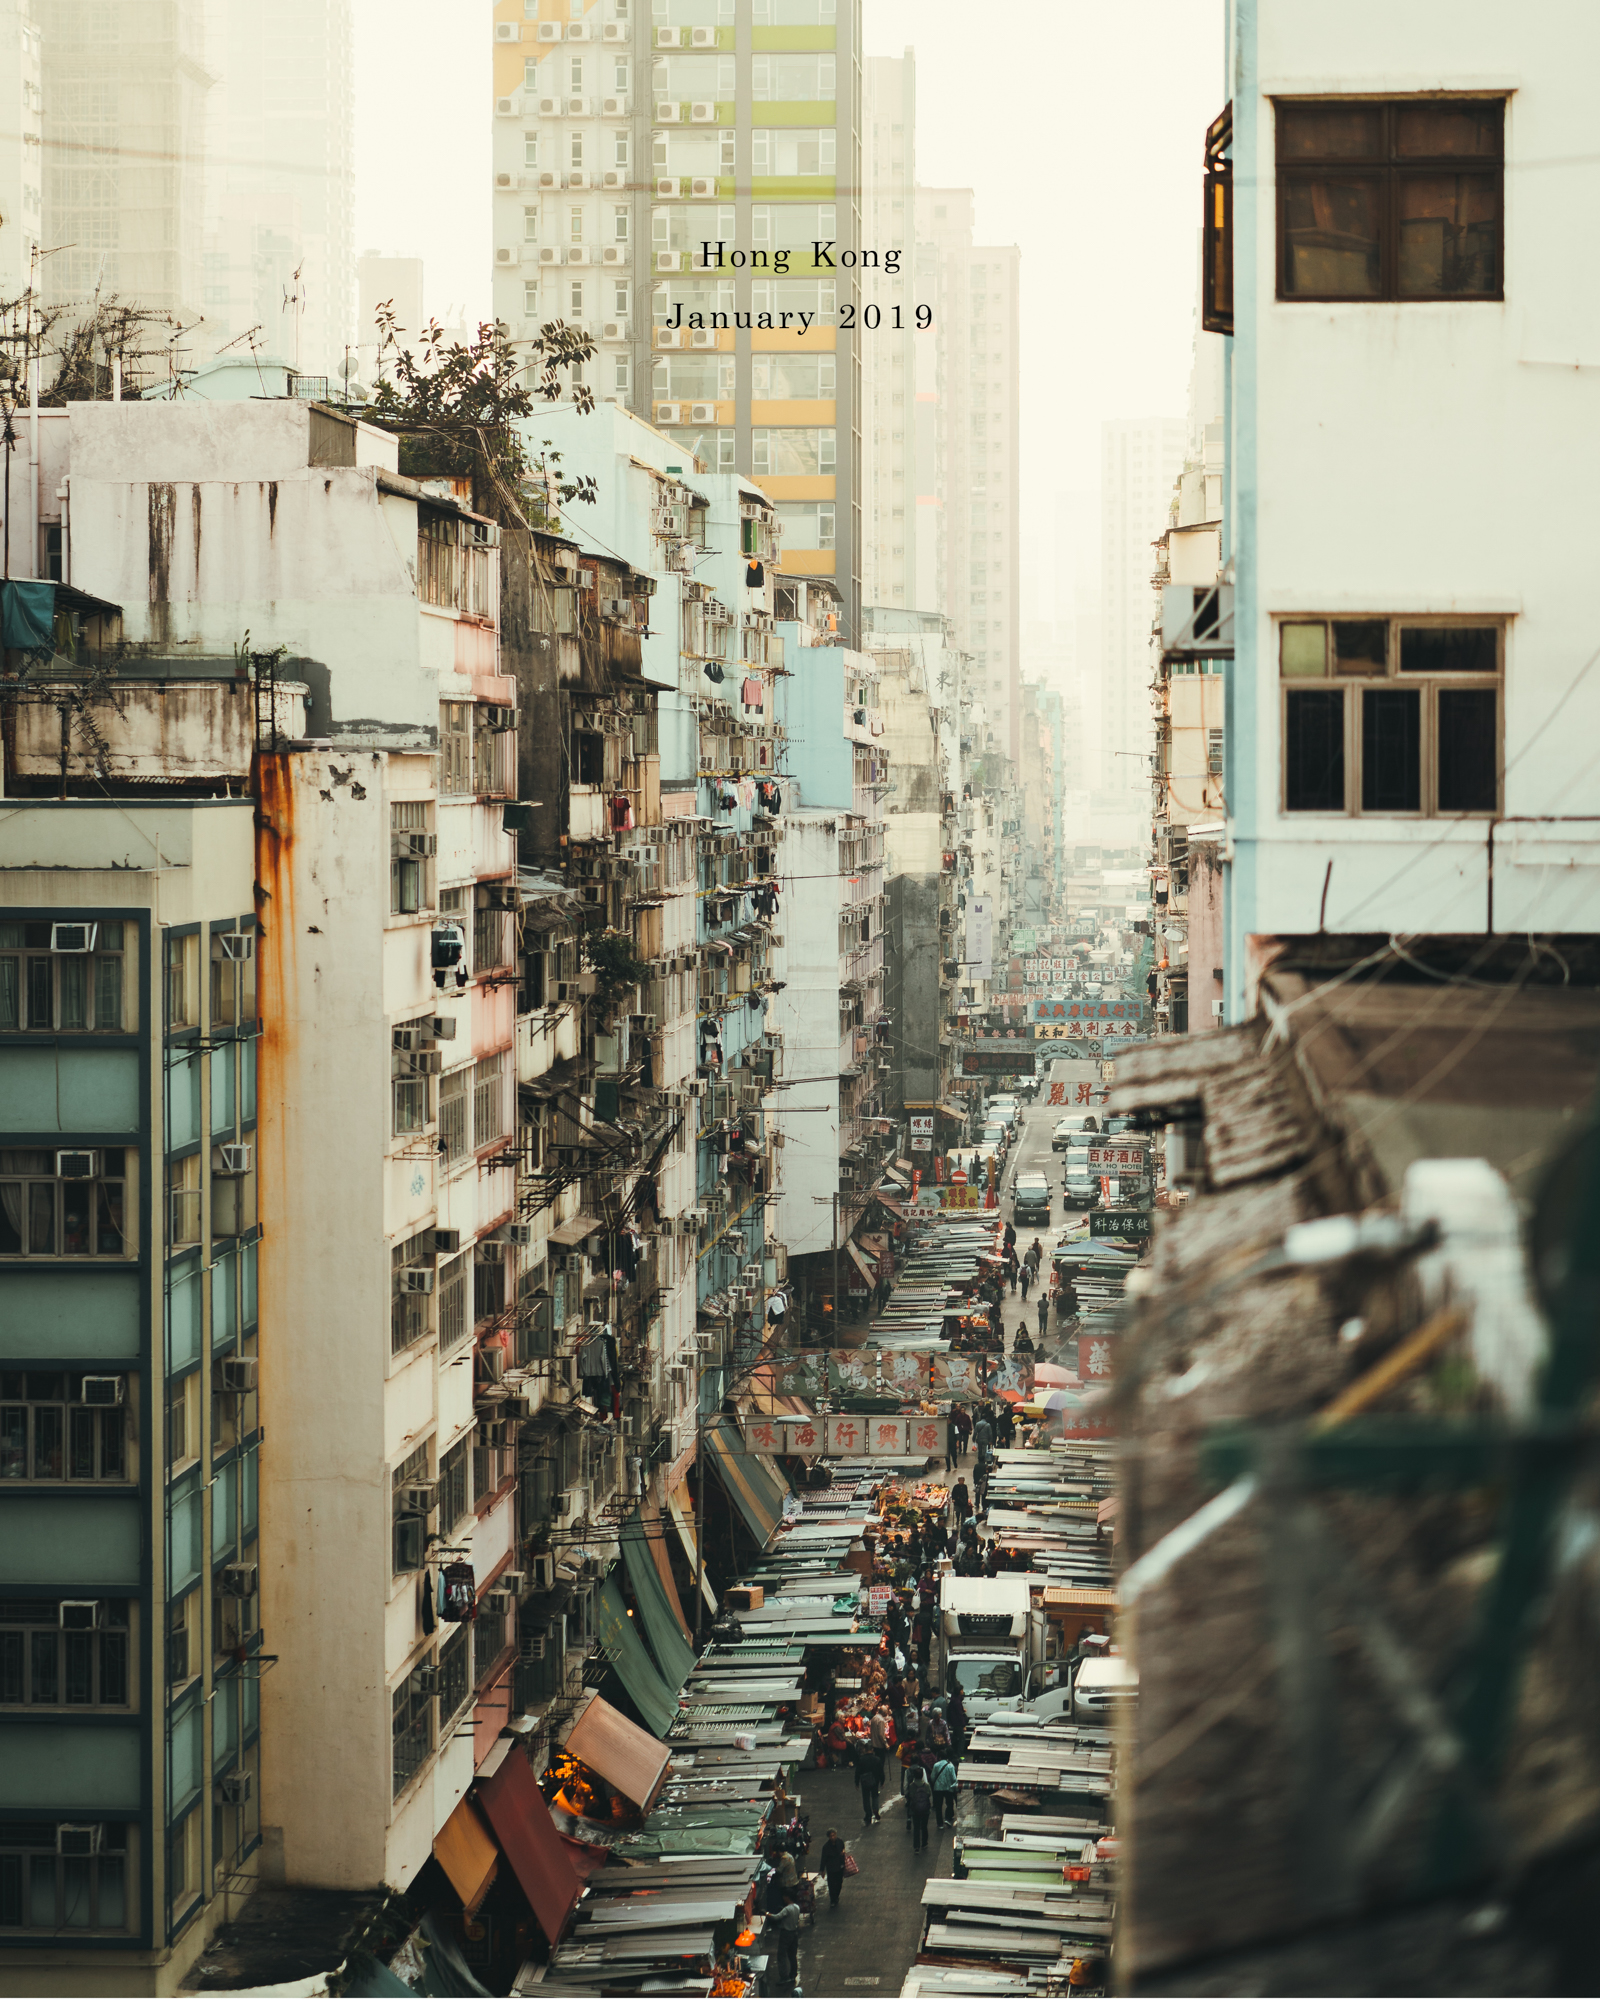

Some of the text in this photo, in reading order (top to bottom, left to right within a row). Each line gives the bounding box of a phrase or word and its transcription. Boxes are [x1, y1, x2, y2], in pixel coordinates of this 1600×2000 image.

[1039, 1026, 1064, 1038] 永和
[1069, 1021, 1136, 1036] 鴻利五金
[1089, 1149, 1143, 1163] 百好酒店
[1094, 1217, 1150, 1232] 科治保健
